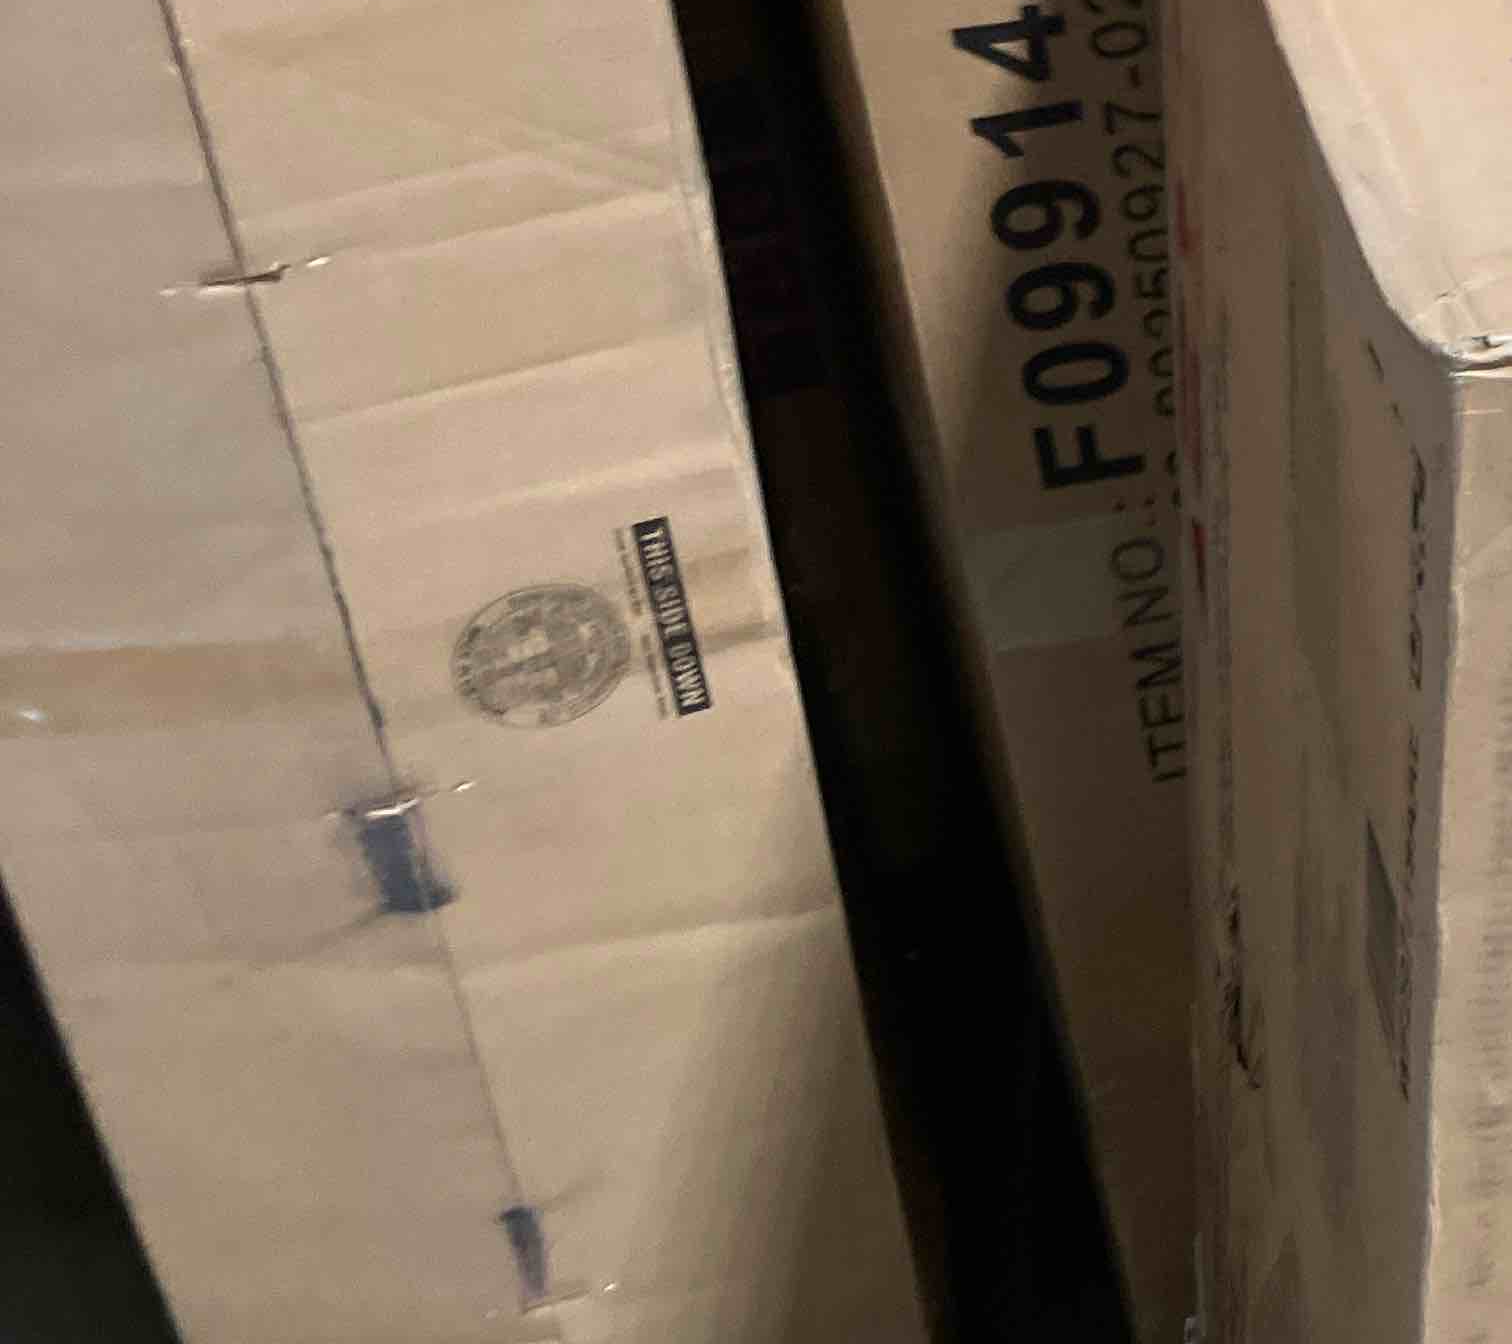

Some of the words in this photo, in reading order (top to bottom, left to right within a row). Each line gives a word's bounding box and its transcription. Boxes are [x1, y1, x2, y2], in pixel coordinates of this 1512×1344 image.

[638, 527, 674, 582] THIS
[654, 584, 691, 641] SIDE
[668, 641, 708, 707] DOWN
